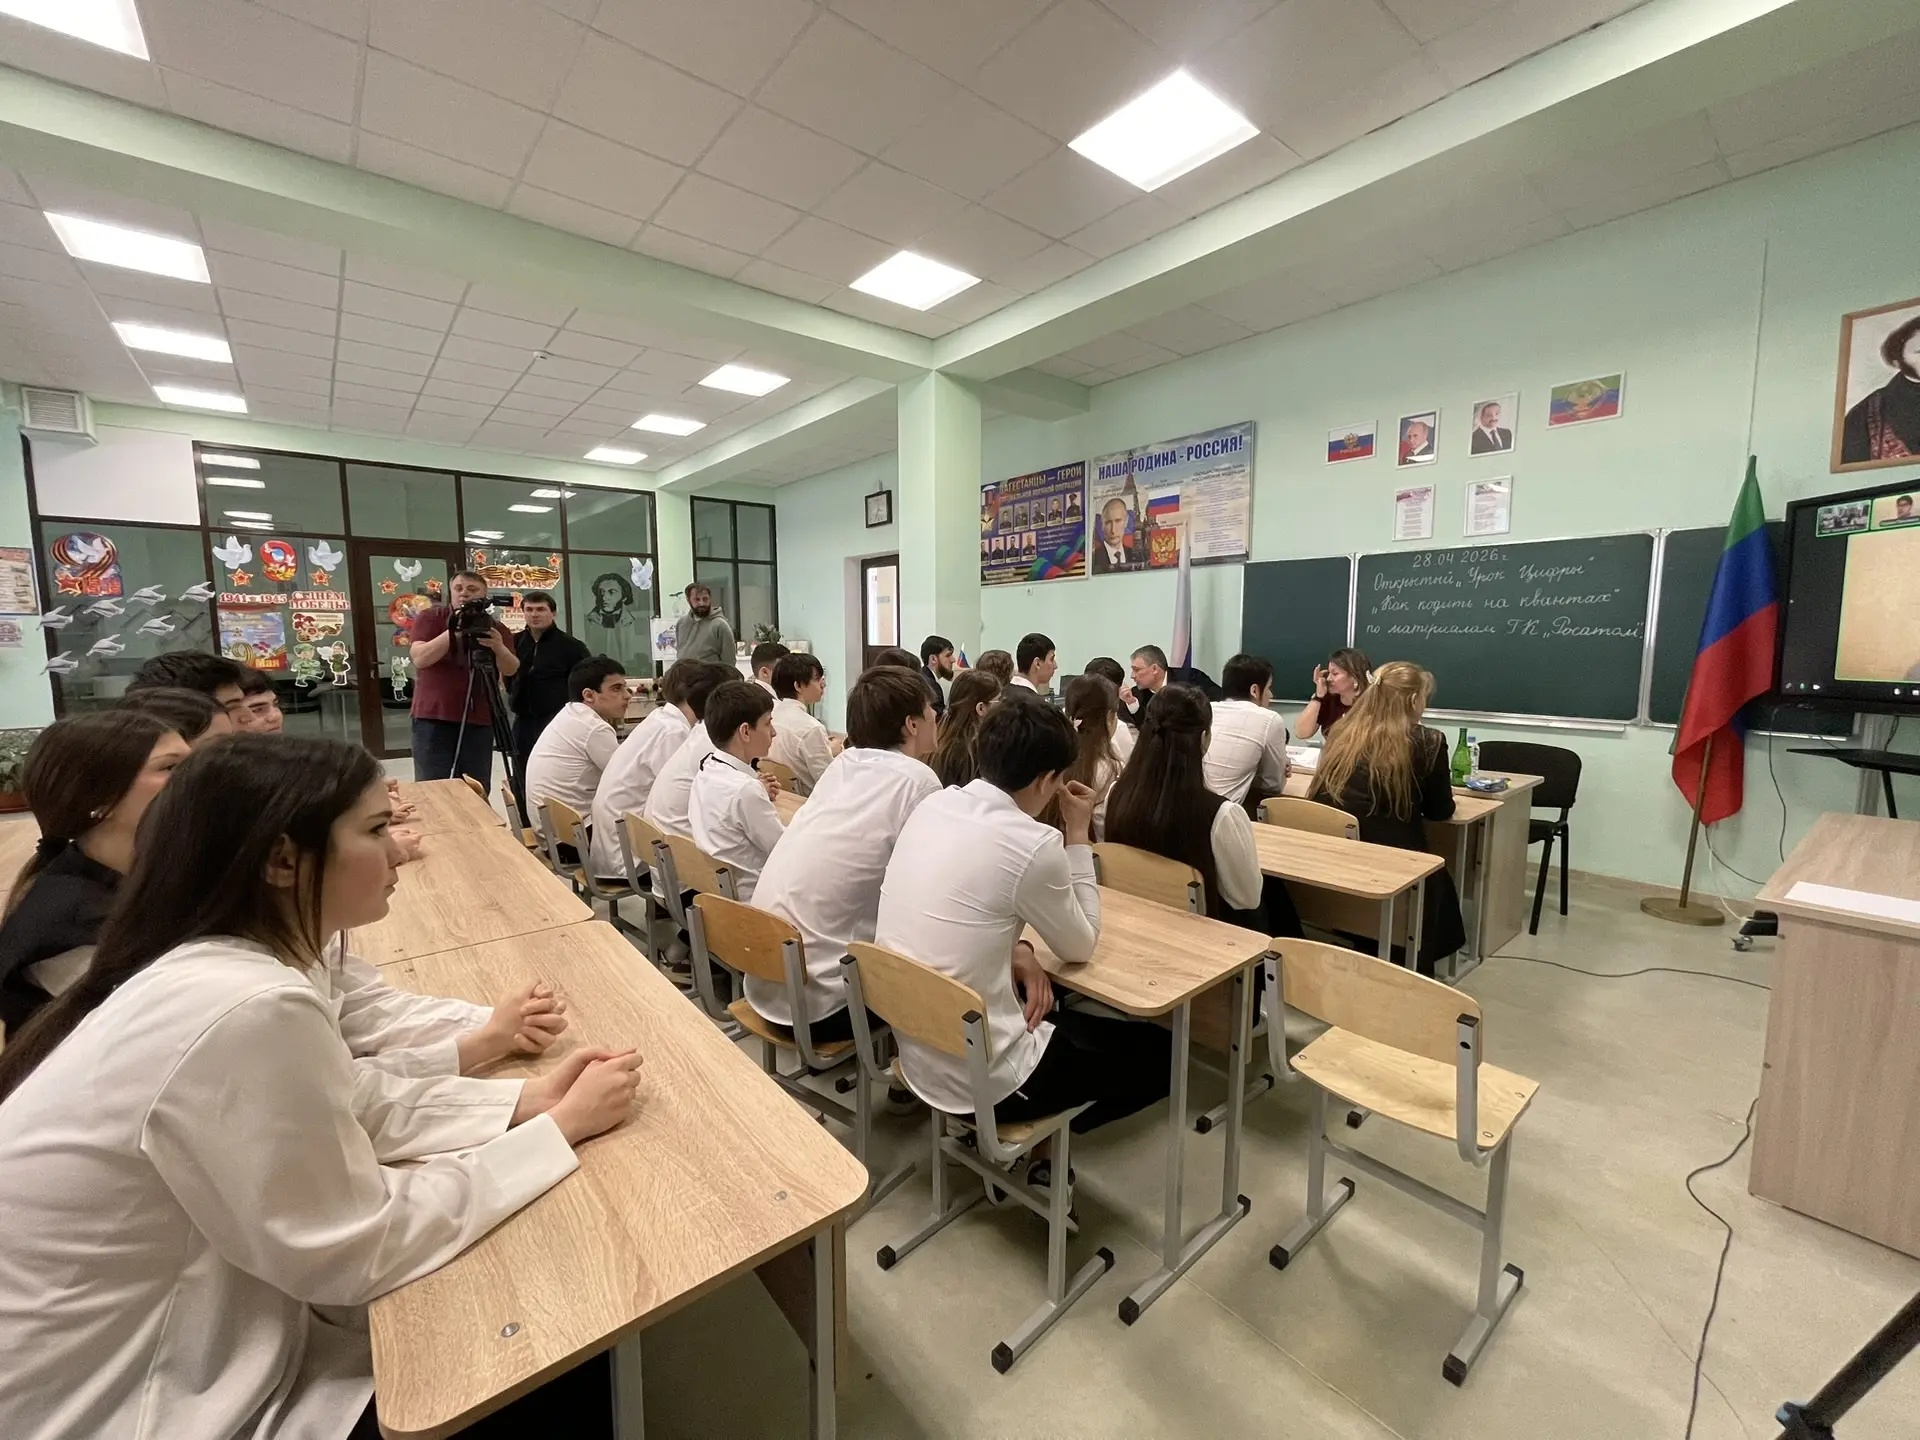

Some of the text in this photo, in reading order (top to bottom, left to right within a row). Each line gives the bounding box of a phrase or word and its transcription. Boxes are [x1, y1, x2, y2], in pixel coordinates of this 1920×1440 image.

[1099, 462, 1129, 480] НАША
[1131, 450, 1177, 473] РОДИНА
[1187, 434, 1243, 461] РОССИЯ!
[1057, 465, 1082, 481] ГЕРОИ
[1374, 571, 1454, 593] Открытый
[220, 592, 287, 604] 1941 1945
[290, 600, 350, 610] ПОБЕДЫ!
[1418, 599, 1472, 616] кодить
[1484, 598, 1509, 608] на
[1366, 624, 1381, 634] по
[1388, 623, 1496, 640] материалам
[255, 658, 280, 668] Мая
